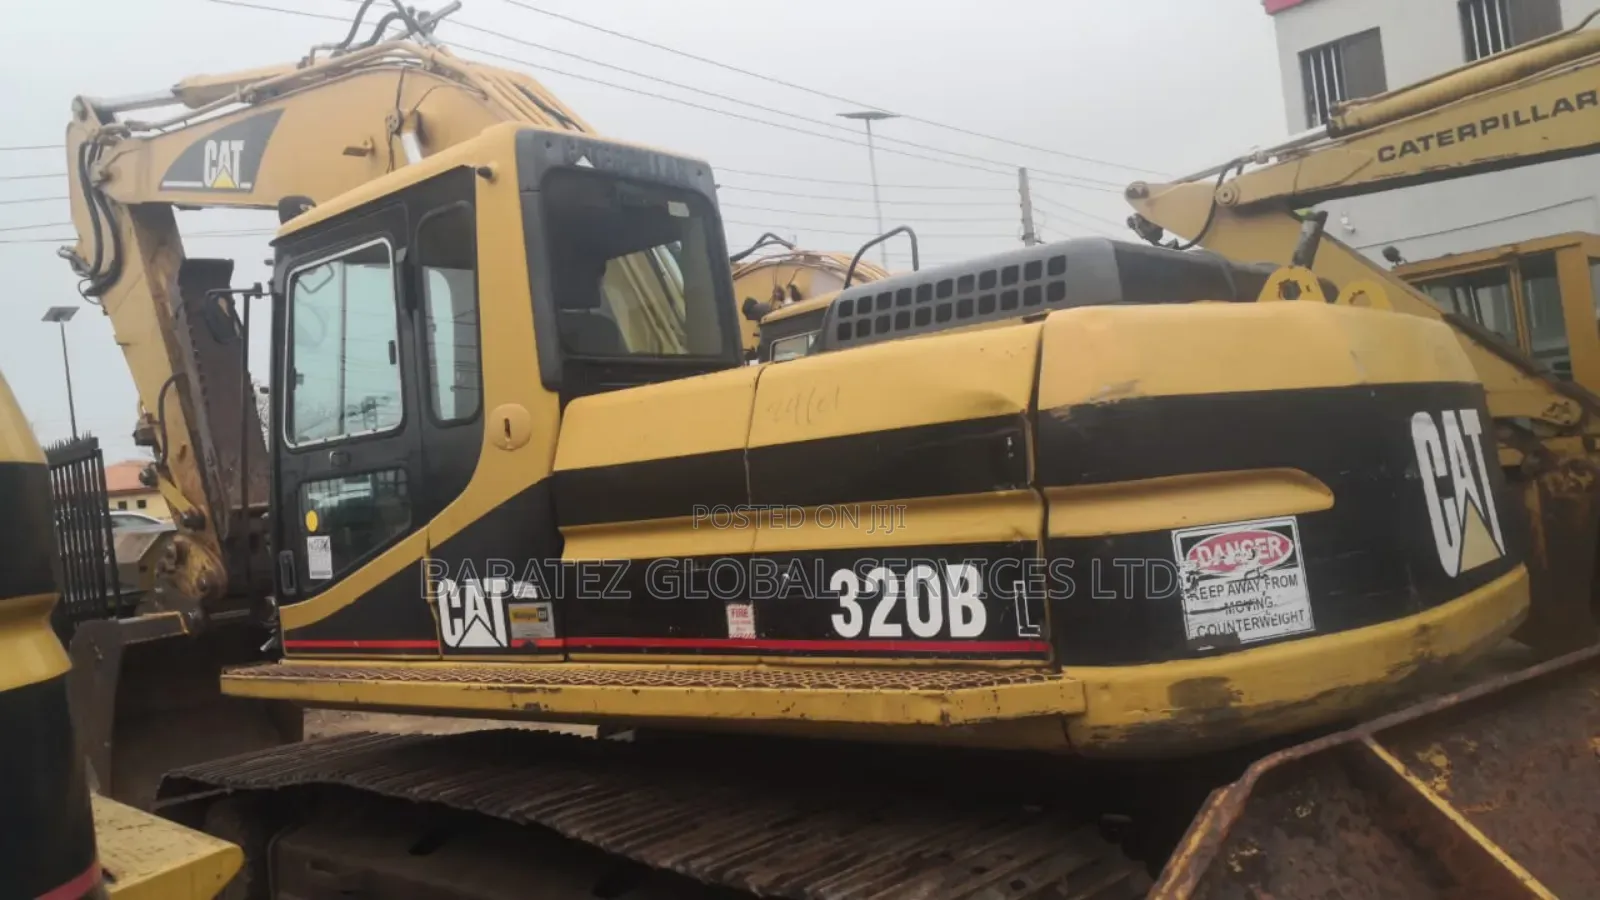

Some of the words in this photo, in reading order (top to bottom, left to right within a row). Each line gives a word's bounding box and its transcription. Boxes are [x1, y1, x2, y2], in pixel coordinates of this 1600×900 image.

[1377, 89, 1599, 163] CATERPILLAR
[203, 139, 245, 189] CAT
[1411, 409, 1506, 578] CAT
[1195, 535, 1283, 569] DANGER
[829, 564, 988, 638] 320B
[1013, 580, 1041, 637] L
[1228, 578, 1261, 597] AWAY
[1263, 573, 1299, 591] FROM
[437, 578, 508, 648] CAT
[730, 607, 749, 618] FIRE
[1197, 609, 1305, 637] COUNTERWEIGHT
